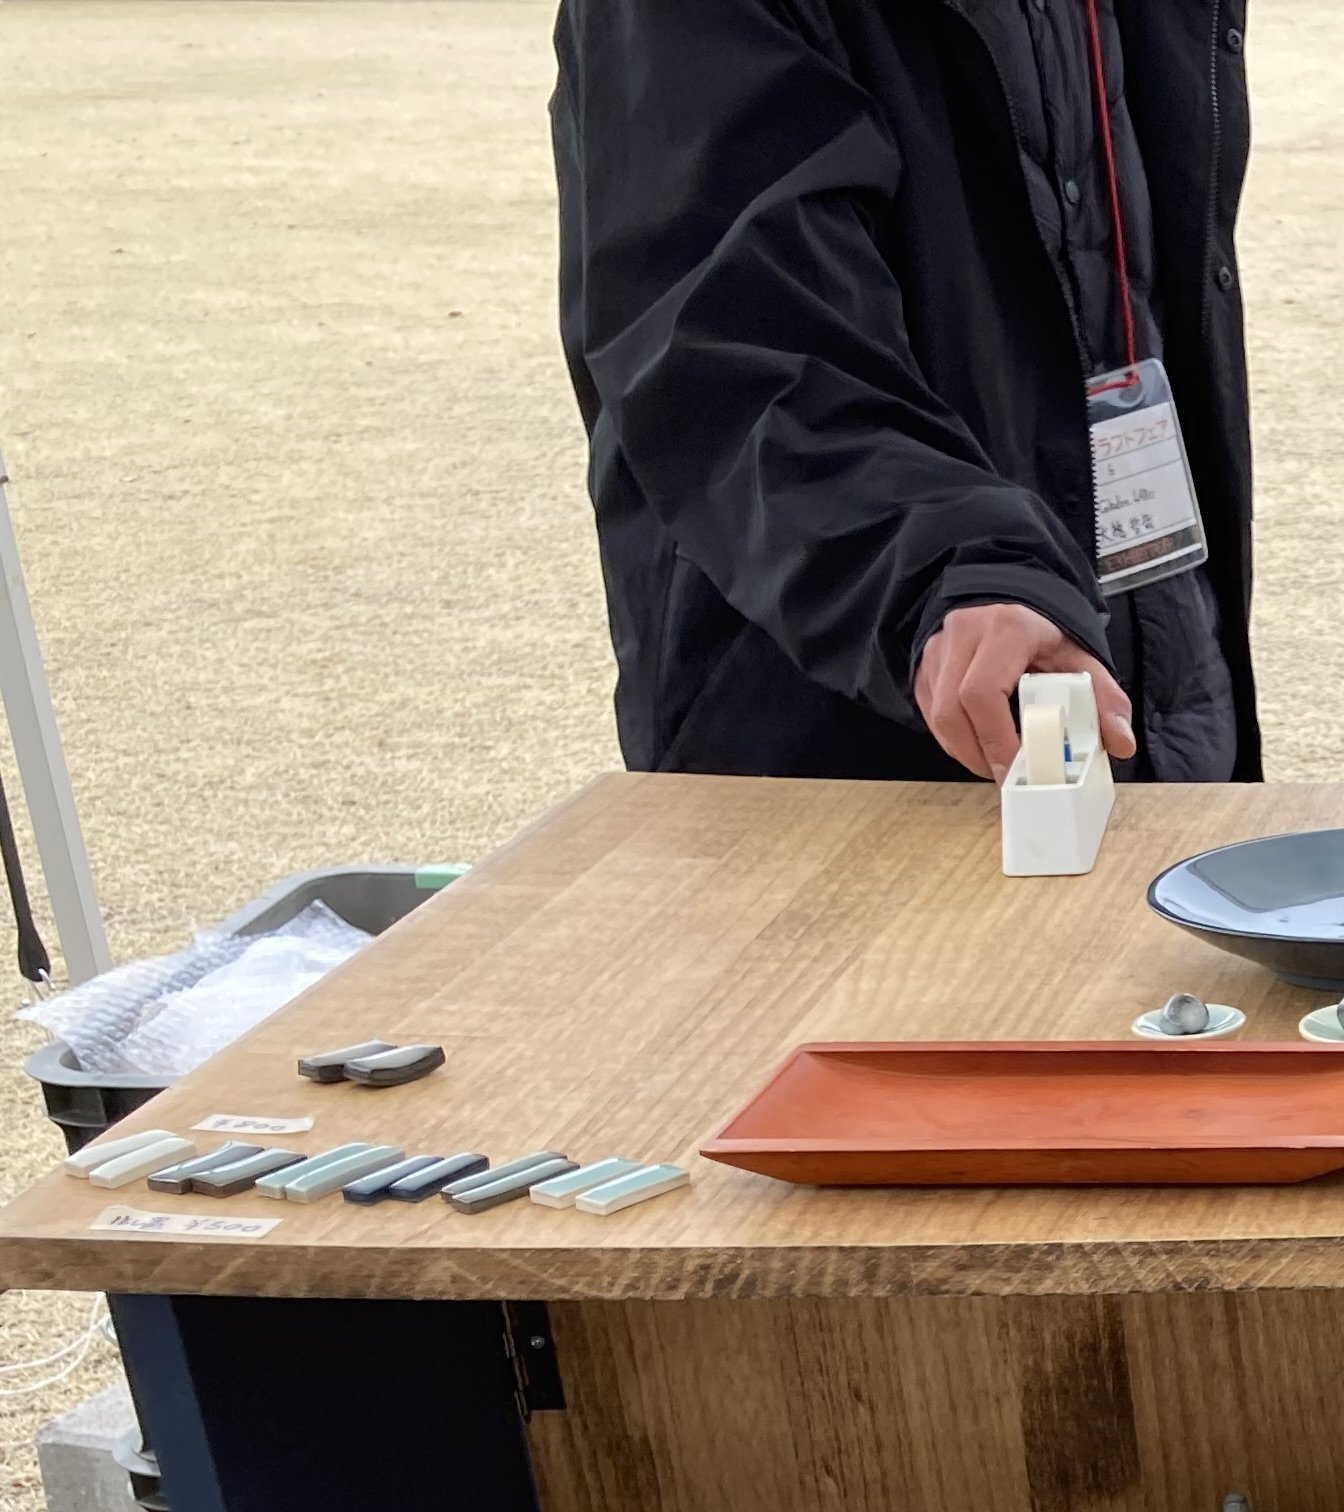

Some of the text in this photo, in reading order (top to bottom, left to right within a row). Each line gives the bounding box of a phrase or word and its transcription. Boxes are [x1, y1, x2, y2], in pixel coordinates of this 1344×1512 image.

[1095, 419, 1168, 458] ラフトフェア
